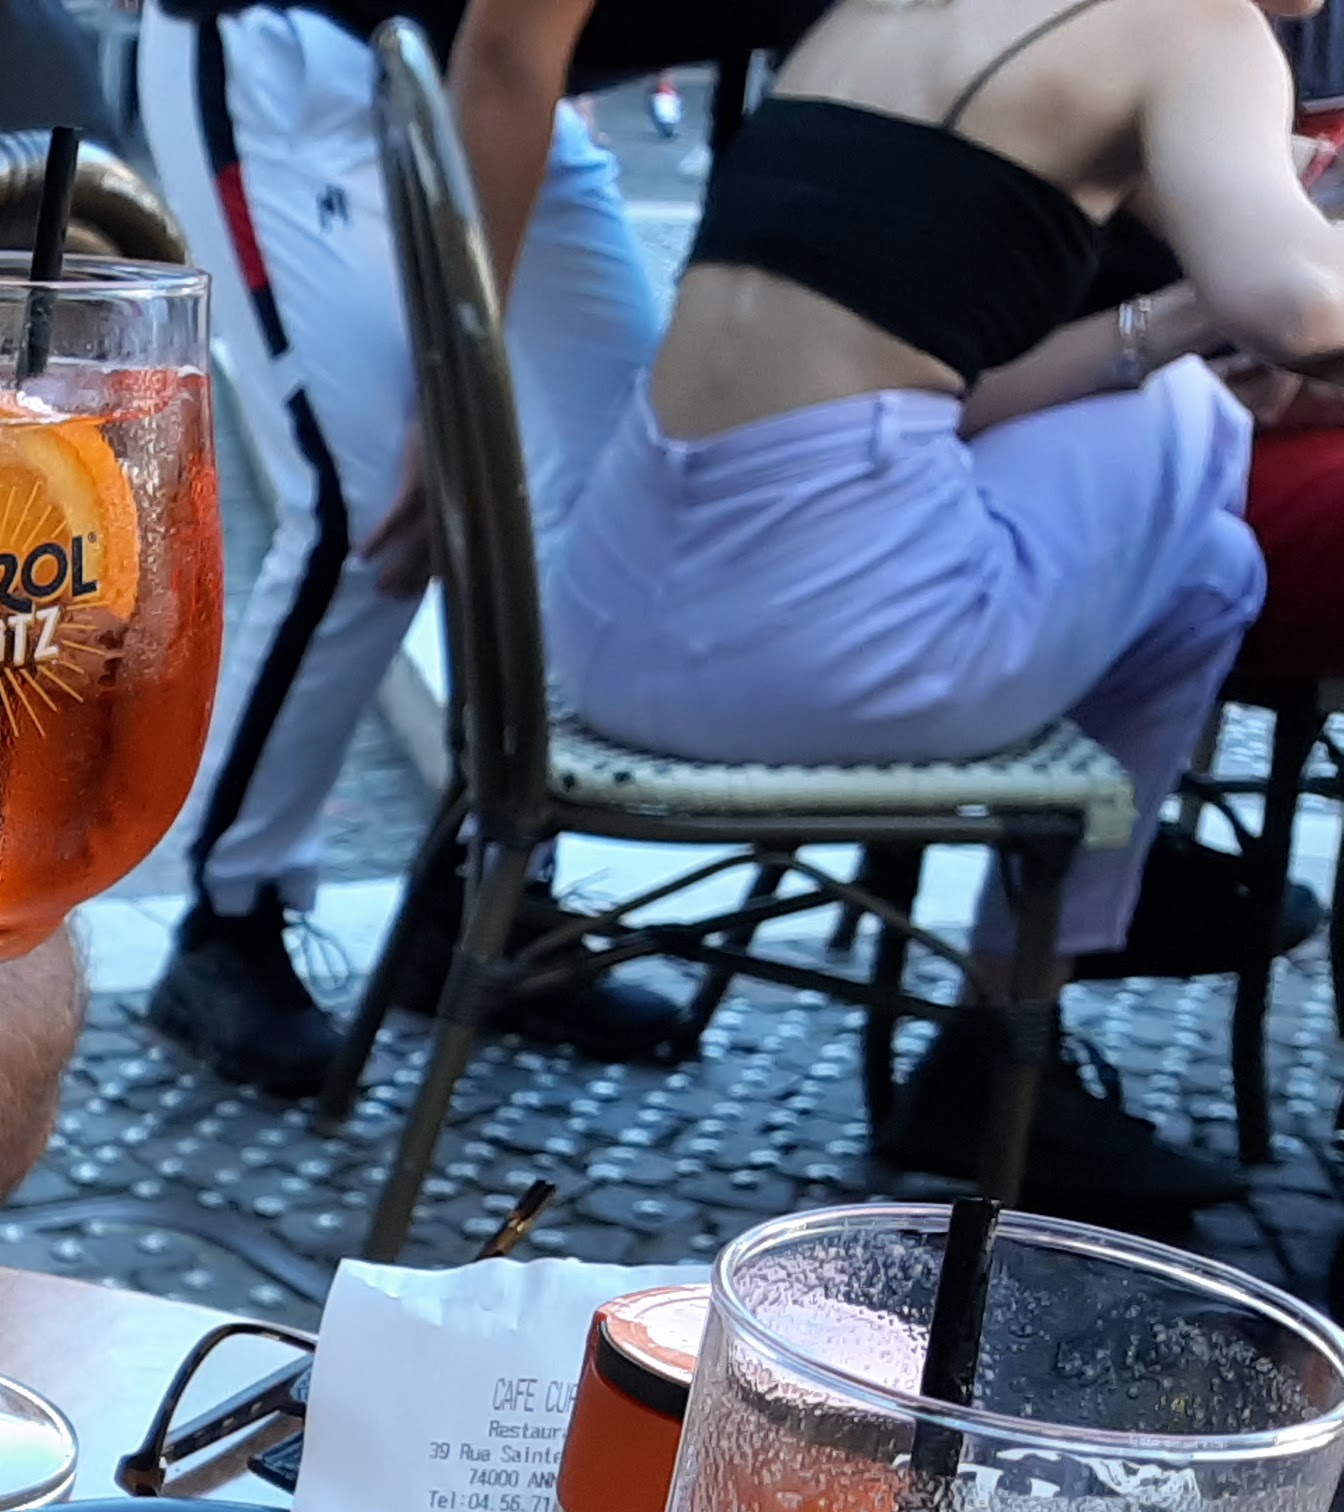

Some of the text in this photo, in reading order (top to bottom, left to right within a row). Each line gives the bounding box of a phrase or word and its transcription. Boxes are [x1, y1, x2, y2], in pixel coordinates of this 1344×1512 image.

[492, 1378, 538, 1412] CAFE
[429, 1442, 562, 1465] 39 Rue Sainte
[469, 1468, 519, 1487] 74000
